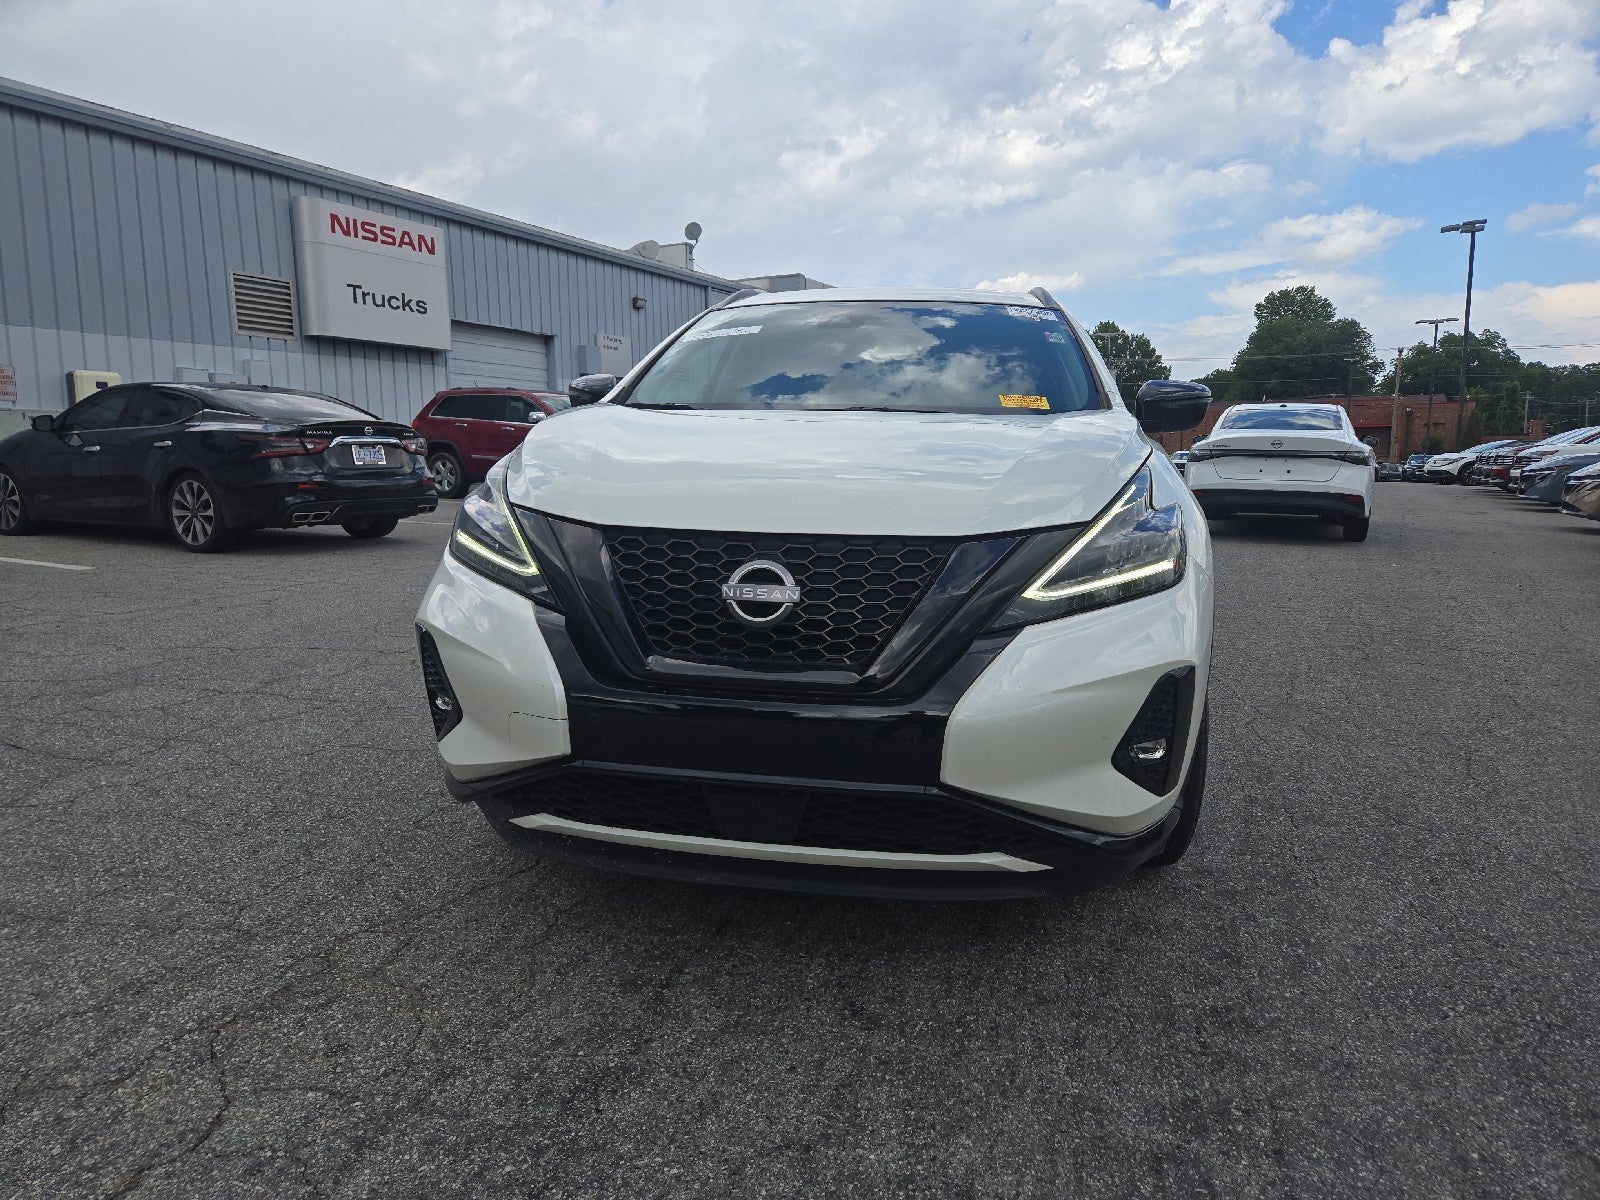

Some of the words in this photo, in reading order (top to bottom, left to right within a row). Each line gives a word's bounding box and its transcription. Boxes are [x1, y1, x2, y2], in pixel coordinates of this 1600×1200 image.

[330, 213, 435, 255] NISSAN
[346, 283, 428, 315] Trucks
[723, 586, 799, 600] NISSAN
